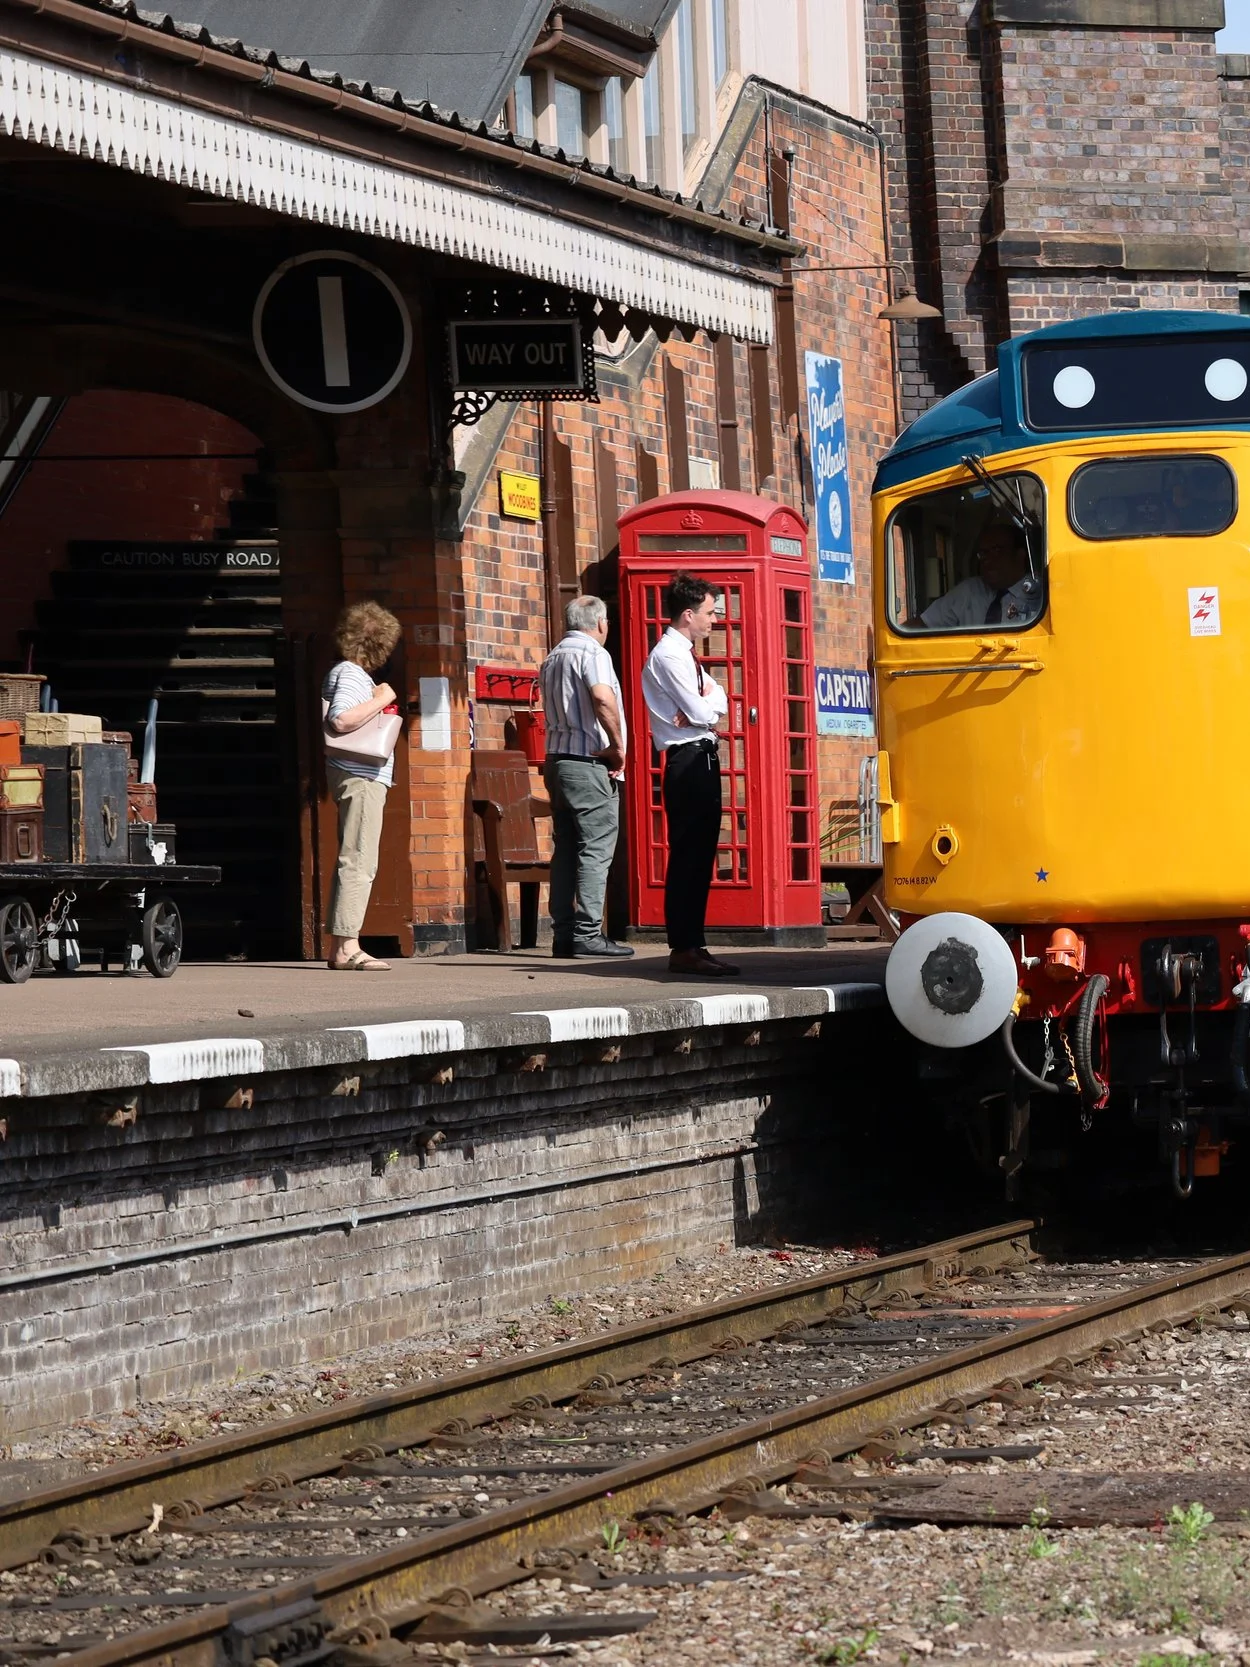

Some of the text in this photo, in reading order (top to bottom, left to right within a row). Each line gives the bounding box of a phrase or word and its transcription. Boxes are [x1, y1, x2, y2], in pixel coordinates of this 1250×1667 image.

[465, 342, 567, 365] WAY OUT
[508, 492, 536, 511] WOODBINES
[101, 552, 174, 566] CAUTION
[183, 552, 219, 566] BUSY
[226, 552, 272, 566] ROAD
[817, 672, 871, 709] CAPSTAN
